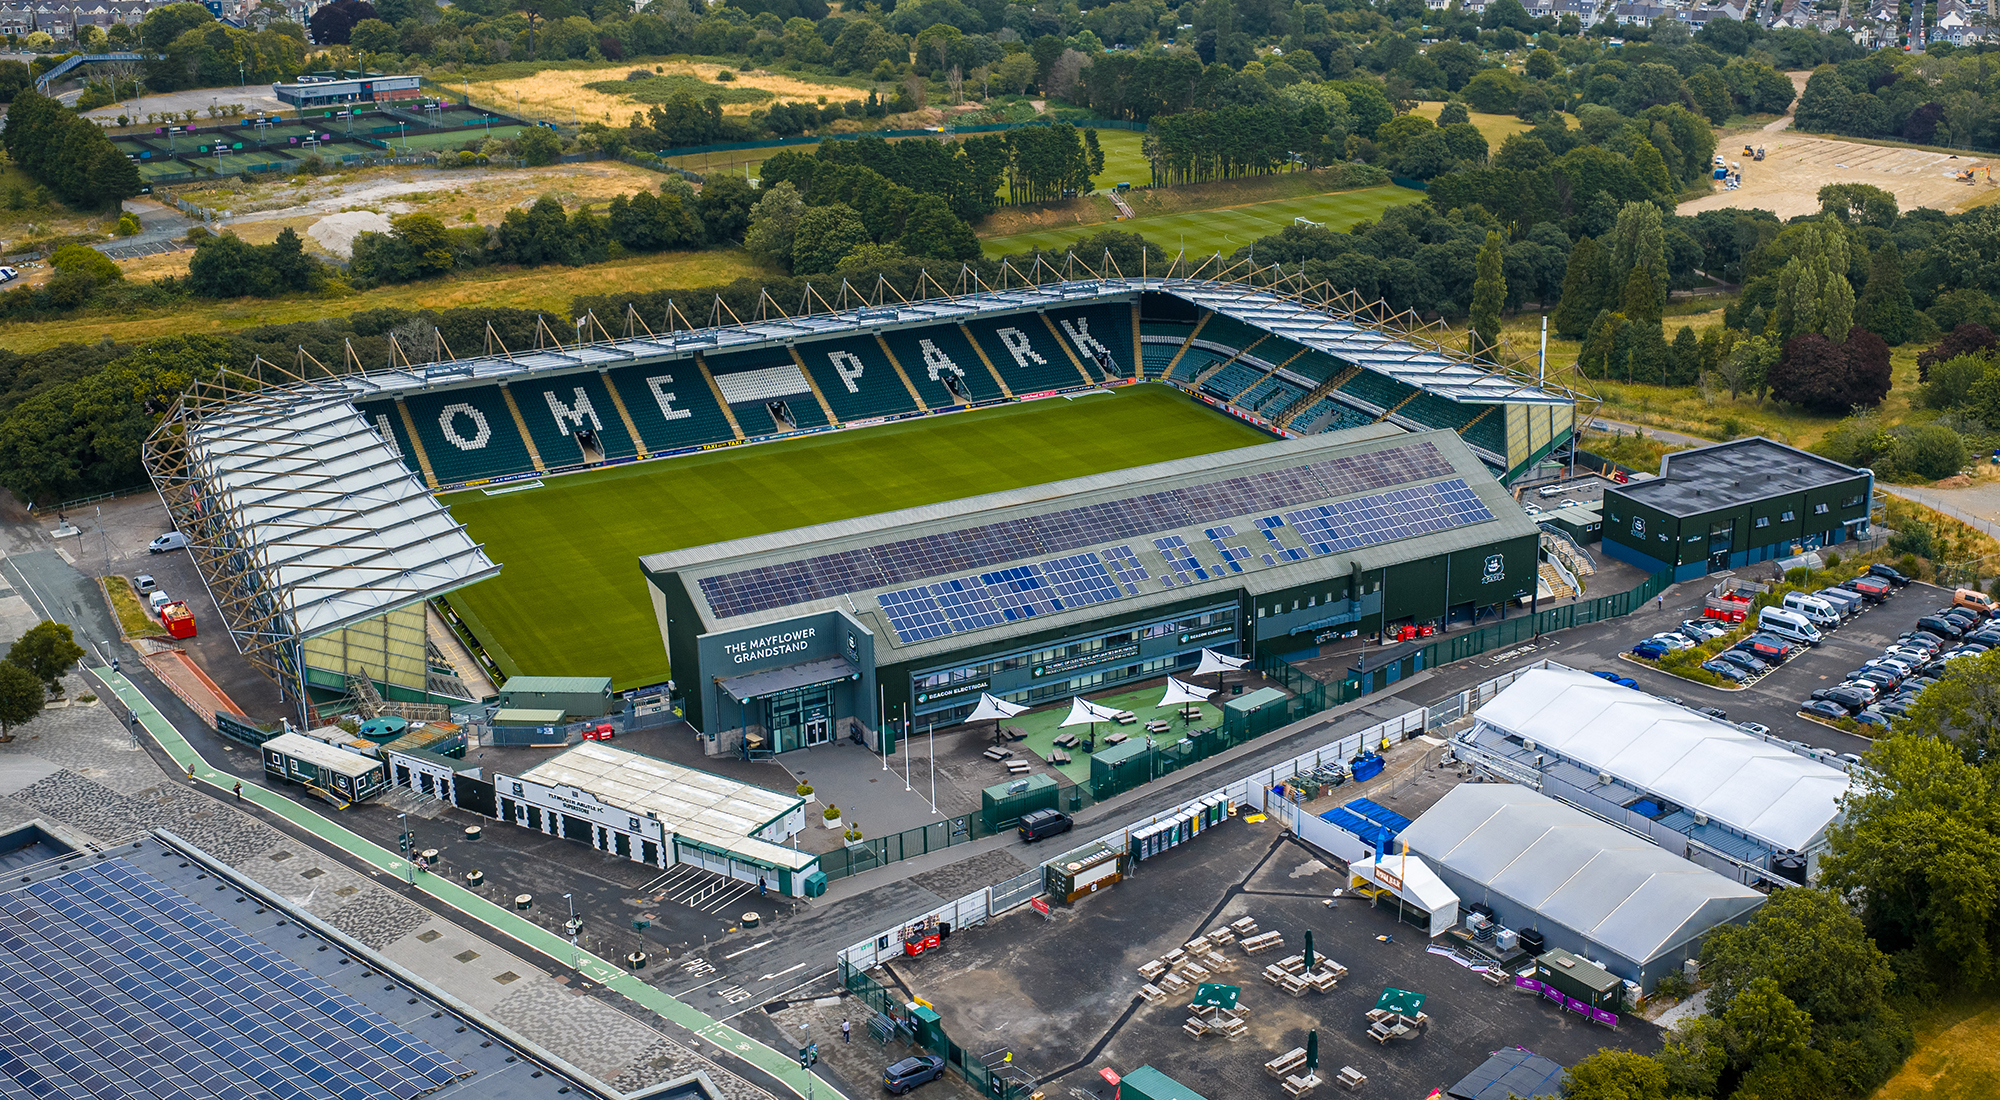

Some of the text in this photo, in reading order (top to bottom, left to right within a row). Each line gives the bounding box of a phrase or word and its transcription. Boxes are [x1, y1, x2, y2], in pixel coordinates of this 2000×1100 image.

[827, 316, 1111, 394] PARK
[724, 627, 816, 655] THE MAYFLOWER
[1190, 632, 1208, 640] BEACON
[733, 640, 809, 664] GRANDSTAND
[929, 681, 988, 700] BEACON ELECTRICAL
[562, 802, 590, 815] SUPERSTORE
[1079, 848, 1113, 866] BURGERS
[680, 957, 718, 978] PAFC
